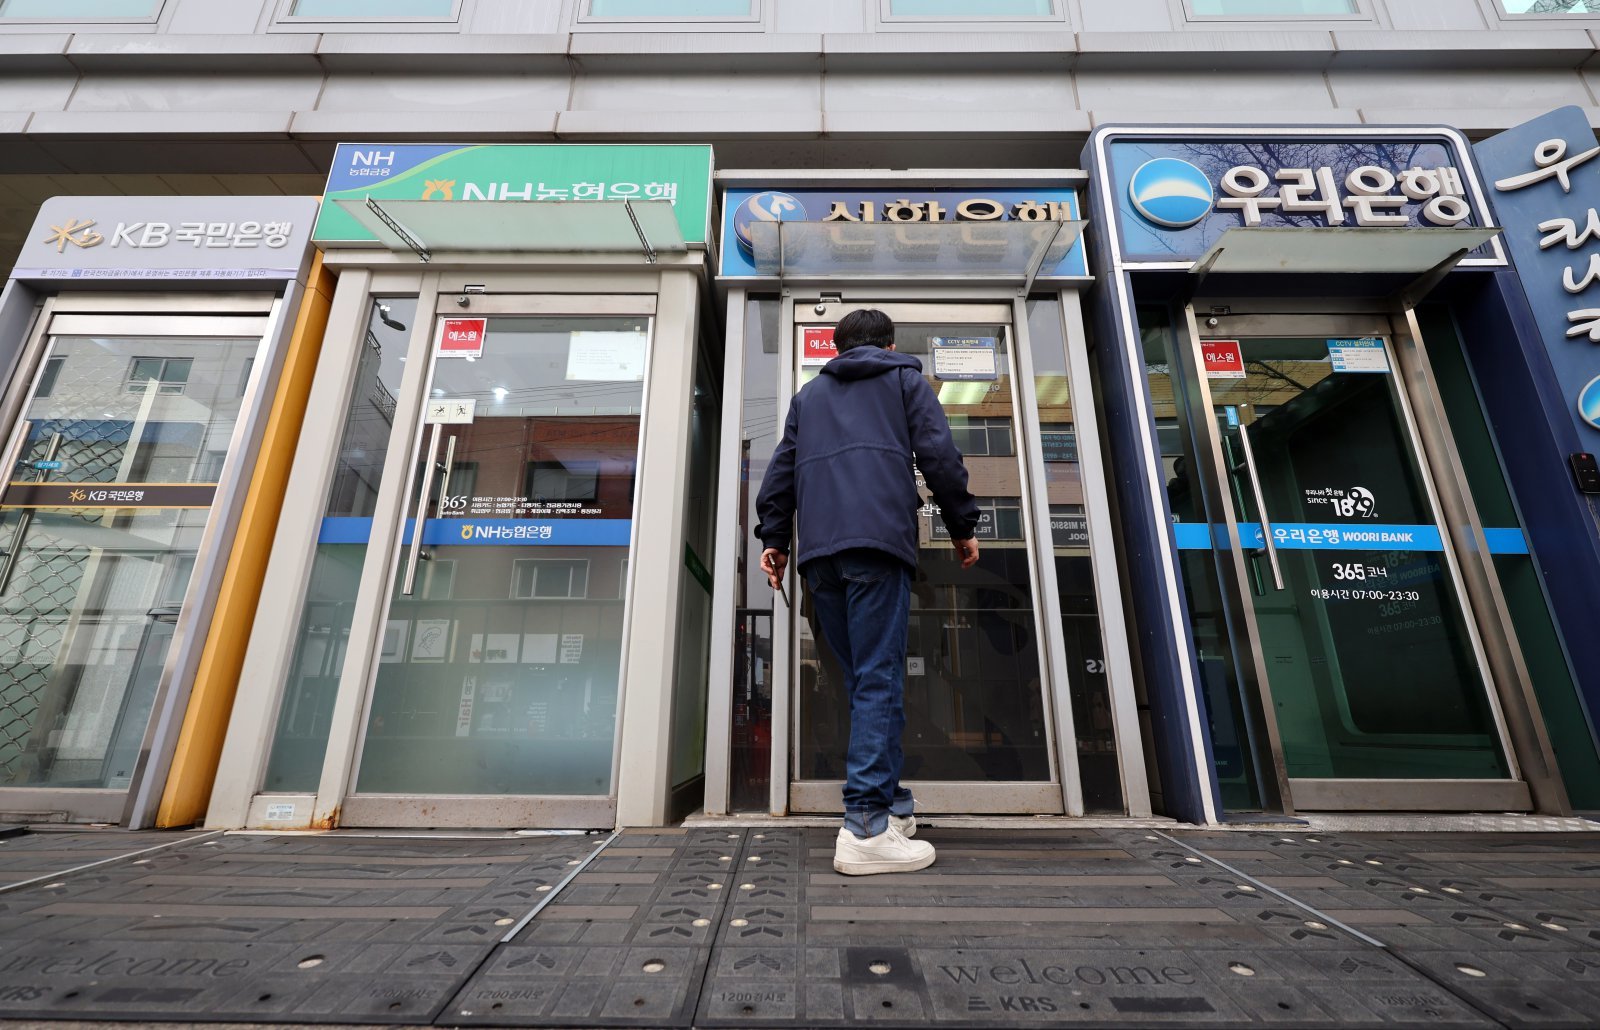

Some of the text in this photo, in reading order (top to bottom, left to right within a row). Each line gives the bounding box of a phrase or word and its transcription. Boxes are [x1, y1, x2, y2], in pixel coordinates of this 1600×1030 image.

[352, 150, 395, 165] NH
[349, 167, 391, 176] 농협금융
[1216, 164, 1471, 227] 우리은행
[822, 198, 1075, 247] 신한은행
[110, 220, 294, 248] KB 국민은행
[172, 269, 198, 277] 국민은행
[448, 330, 477, 342] 에스원
[1206, 352, 1235, 363] 에스원
[88, 490, 145, 501] KB 국민은행
[1325, 487, 1333, 496] 첫
[441, 495, 468, 509] 365
[1307, 496, 1328, 504] since
[475, 525, 553, 540] NH농협은행
[1273, 528, 1414, 544] 우리은행 WOORI BANK
[1332, 563, 1388, 581] 365 코너
[1310, 589, 1420, 601] 이용시간 07:00~23:30
[937, 958, 1197, 986] welcome
[1000, 996, 1059, 1013] KRS
